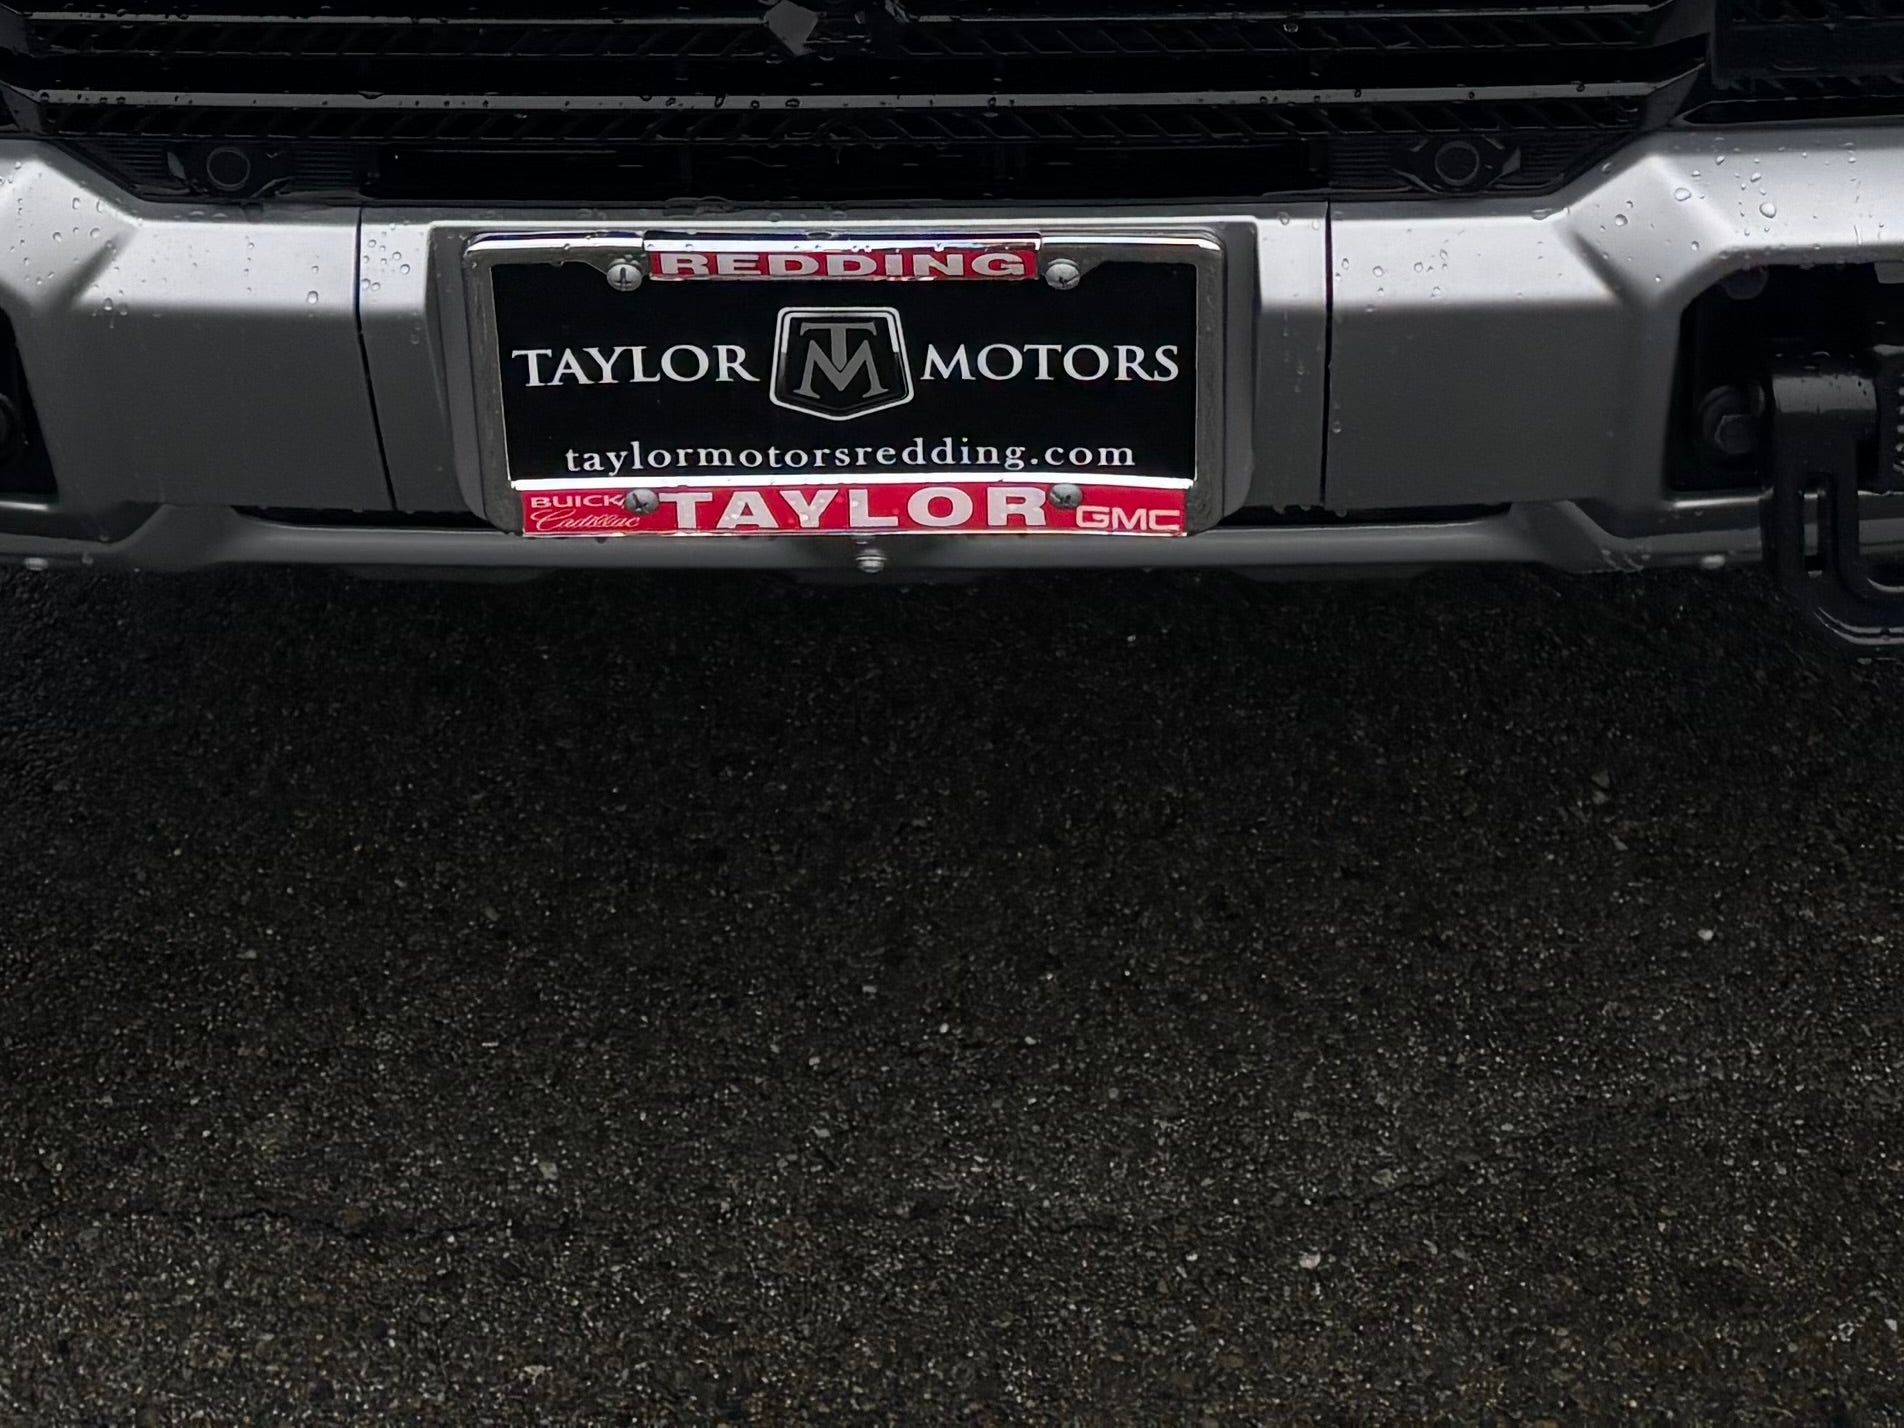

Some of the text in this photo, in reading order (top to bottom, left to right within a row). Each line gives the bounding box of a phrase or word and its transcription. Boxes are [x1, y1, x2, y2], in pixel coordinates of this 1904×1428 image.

[660, 253, 1026, 276] REDDING
[511, 343, 1179, 387] TAYLOR MOTORS
[565, 438, 1134, 476] taylormotorsredding.com
[530, 495, 626, 508] BUICK
[658, 487, 1180, 532] TAYLOR GMC
[530, 509, 641, 531] Cadillac
